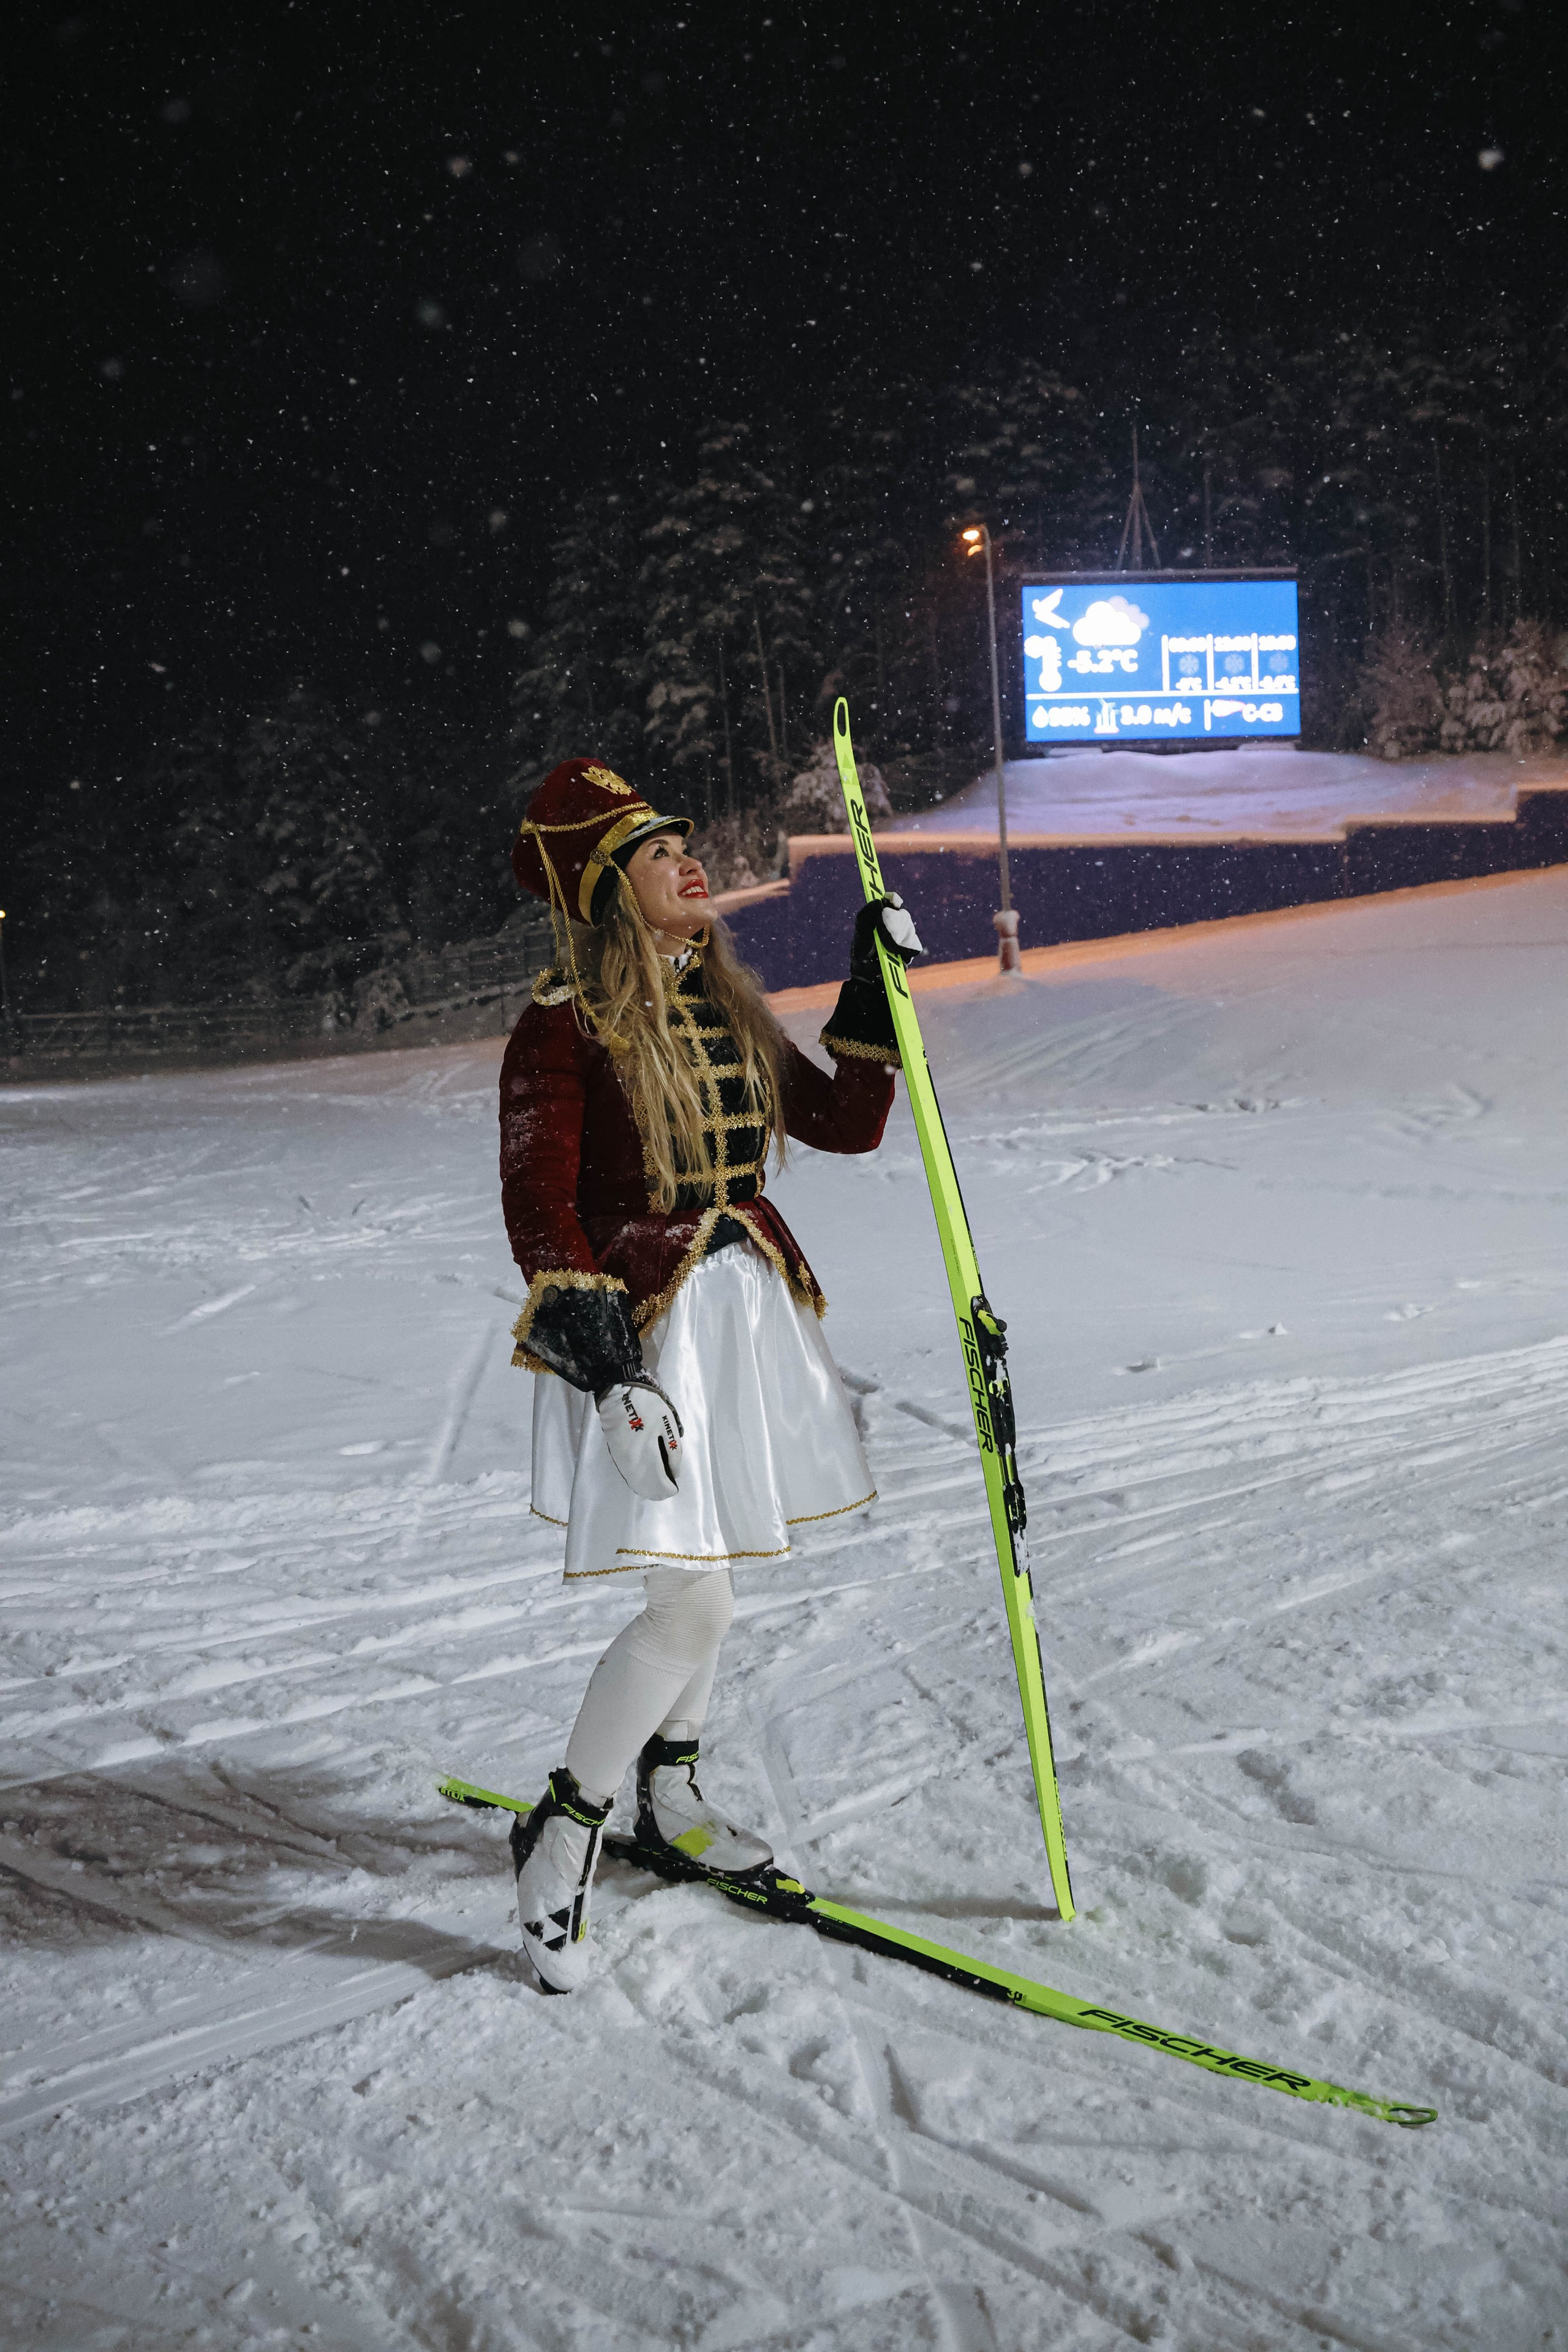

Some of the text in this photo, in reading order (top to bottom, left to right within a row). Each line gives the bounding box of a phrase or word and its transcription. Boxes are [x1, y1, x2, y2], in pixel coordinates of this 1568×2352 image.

[850, 798, 908, 1000] FIHER
[959, 1316, 993, 1453] FISCHER
[706, 1878, 768, 1905] FISCHER
[1076, 2009, 1311, 2092] FISCHER
